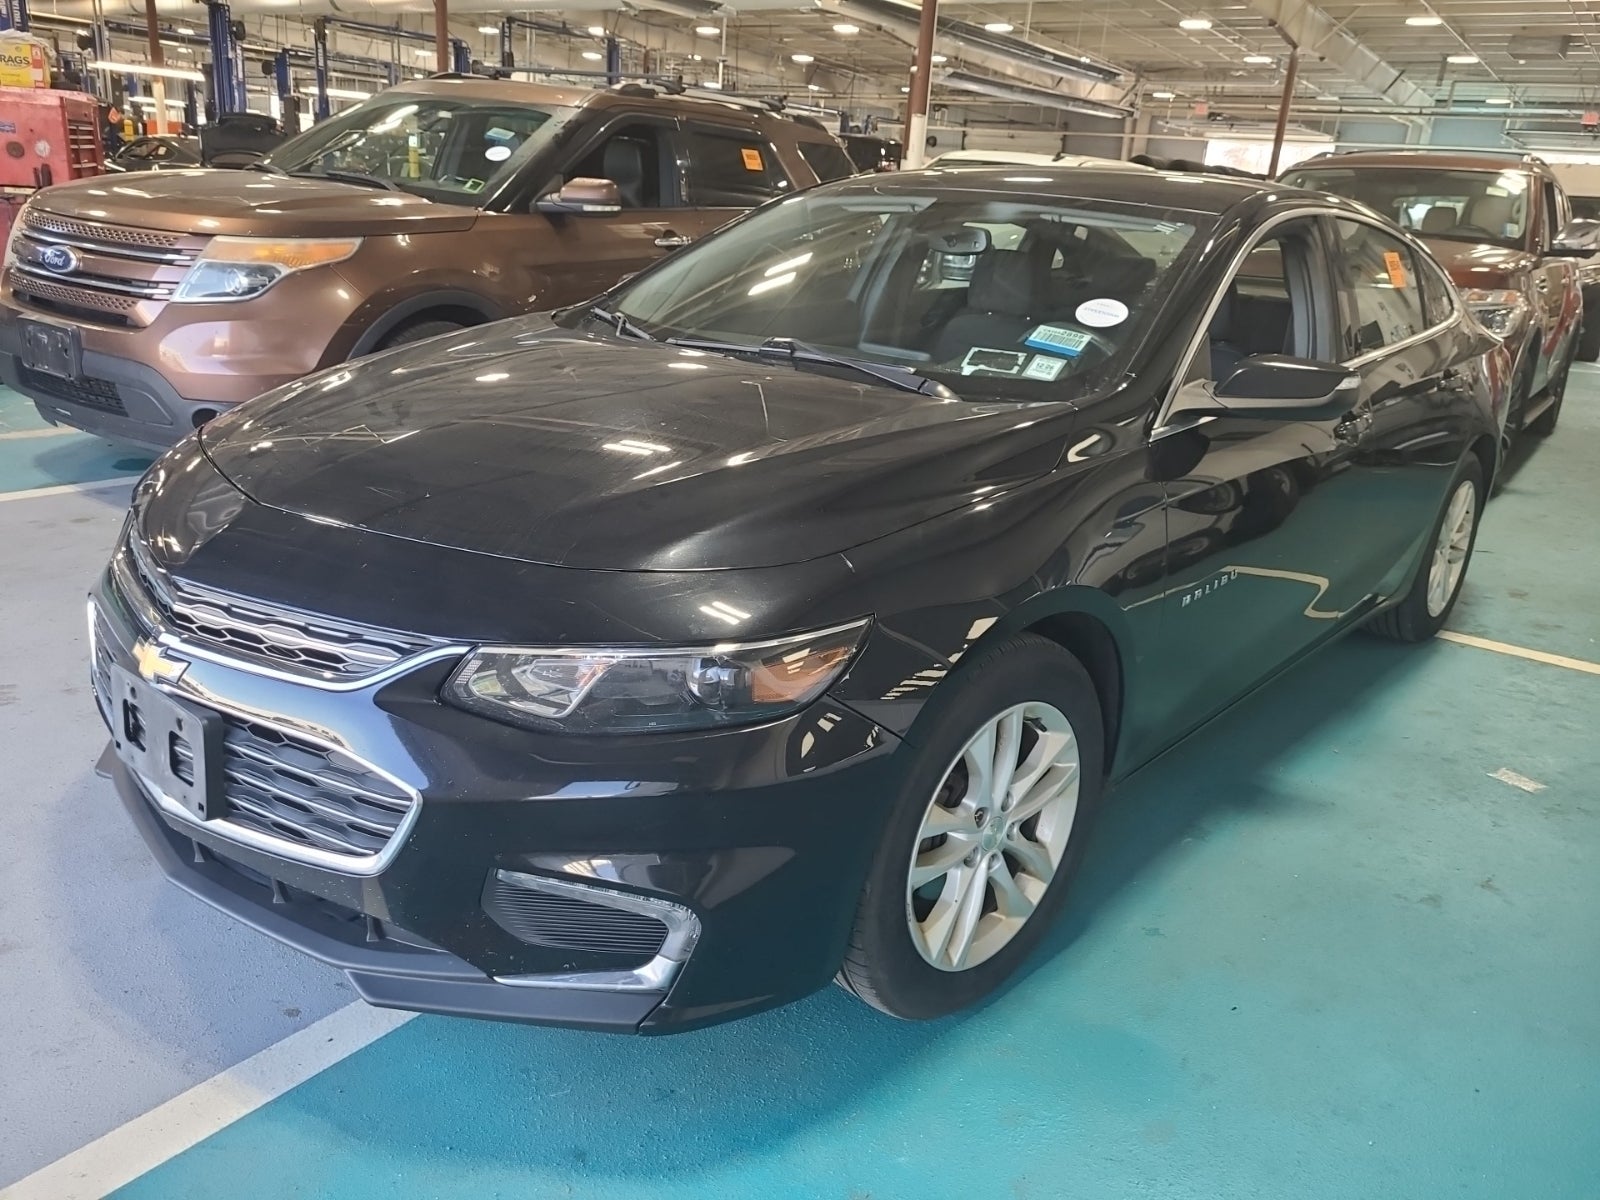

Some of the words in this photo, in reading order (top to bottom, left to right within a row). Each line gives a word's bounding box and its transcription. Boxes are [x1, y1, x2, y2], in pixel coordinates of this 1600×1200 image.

[0, 54, 30, 65] RAGS
[44, 249, 66, 267] Ford
[1182, 569, 1238, 608] MALIBU
